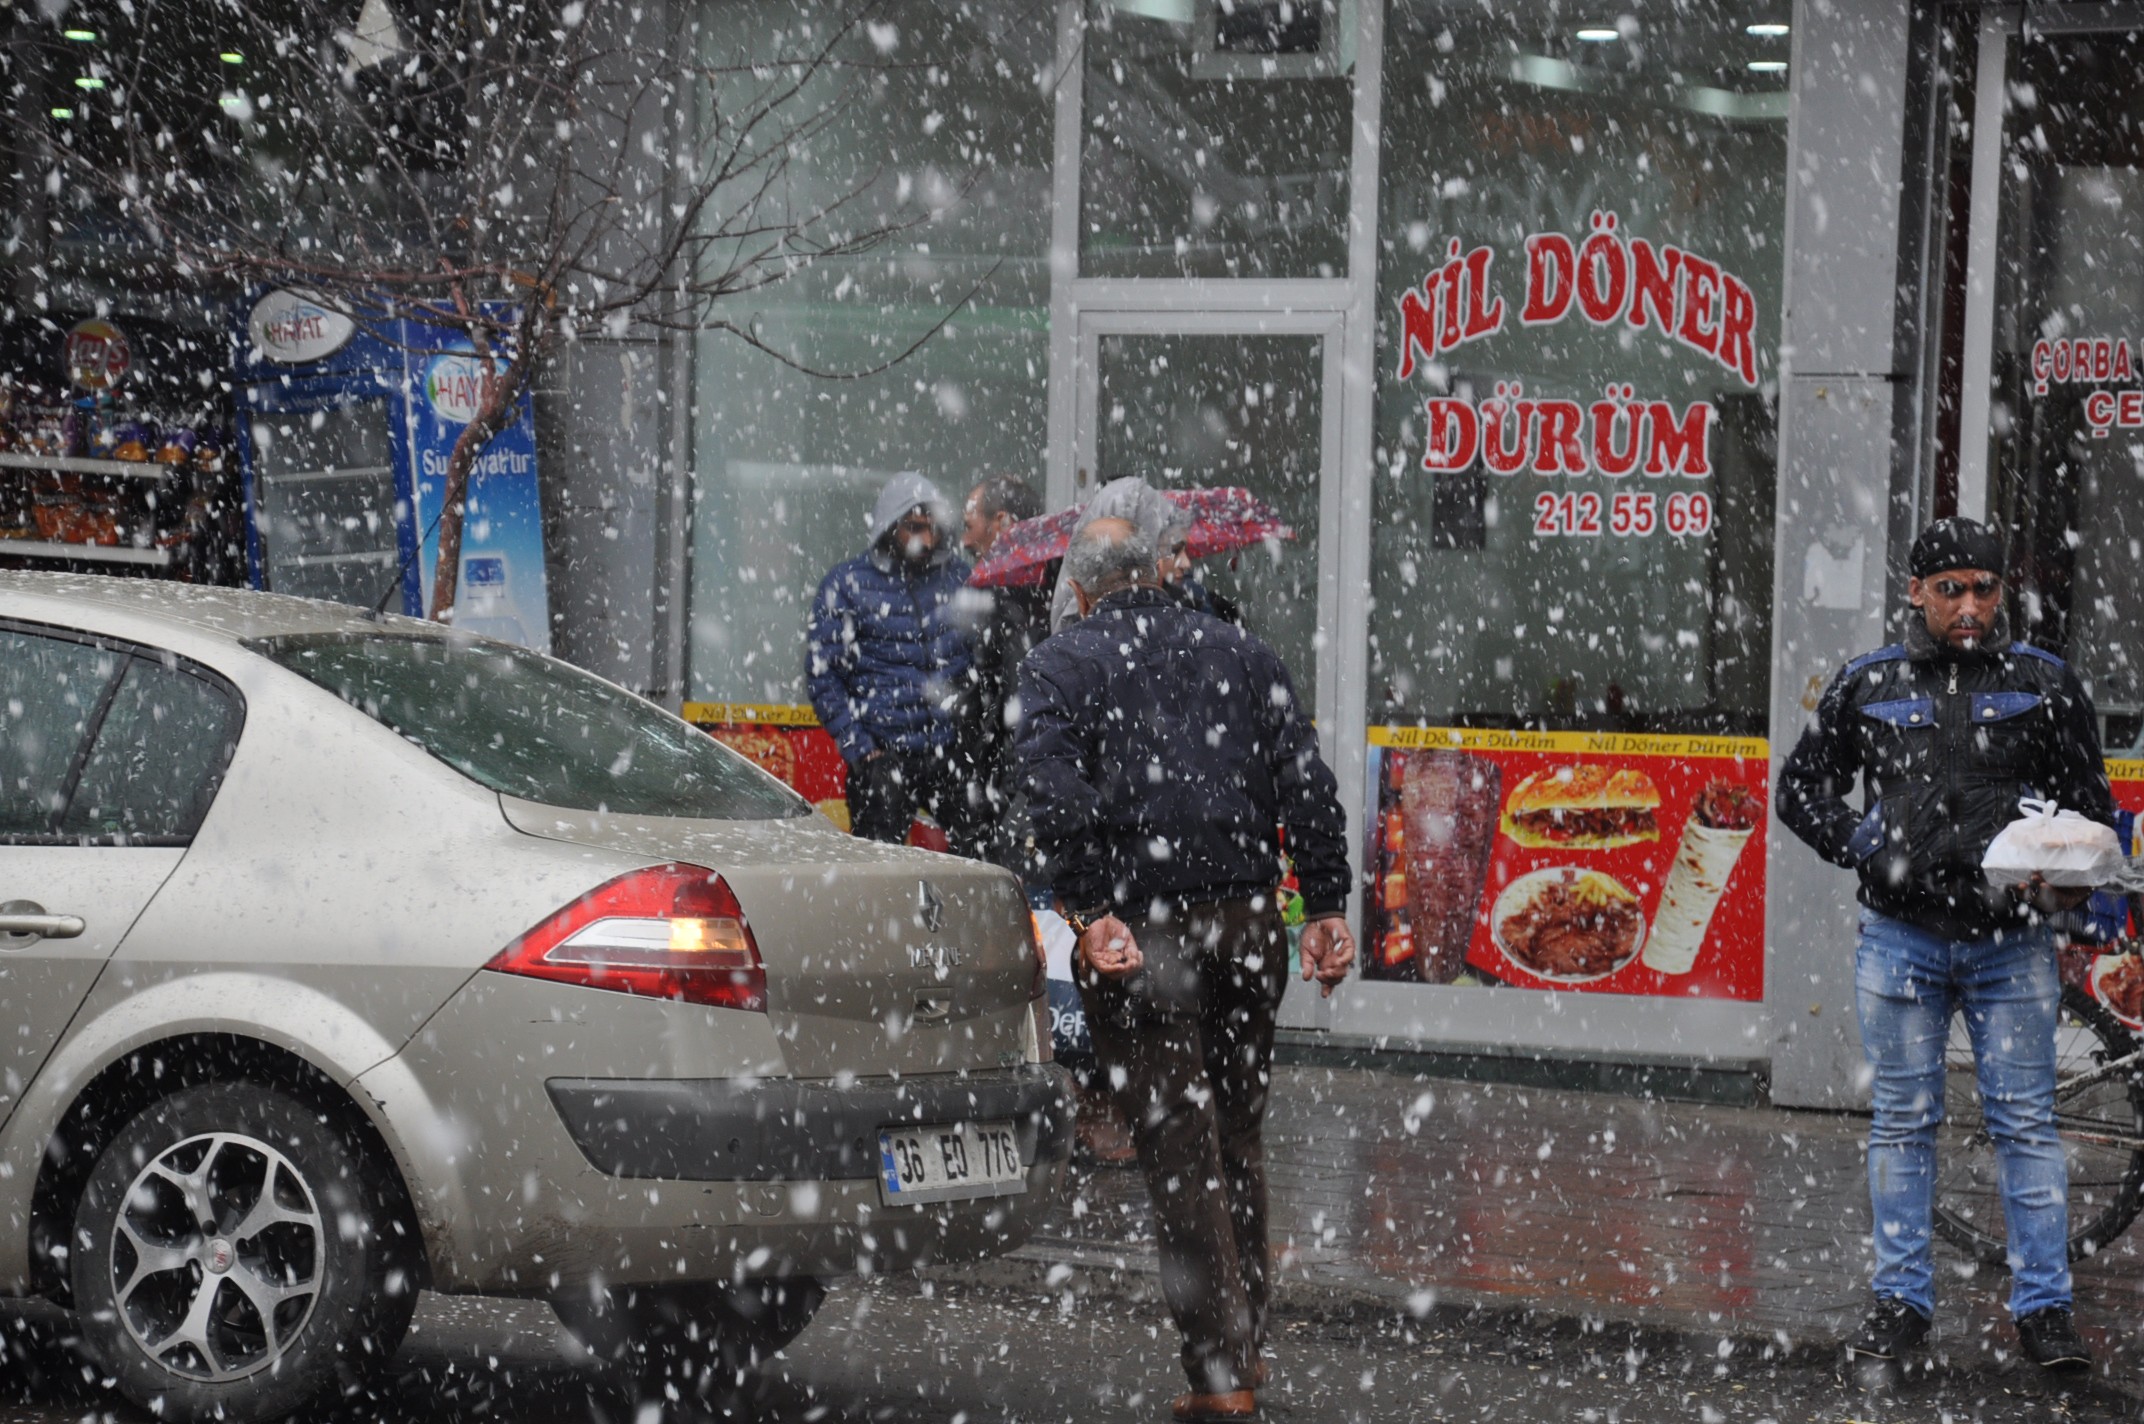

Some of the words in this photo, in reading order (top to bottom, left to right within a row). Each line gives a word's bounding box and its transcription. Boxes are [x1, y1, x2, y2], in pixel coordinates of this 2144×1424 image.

[1397, 235, 1504, 380] NİL
[1520, 209, 1759, 387] DÖNER
[2031, 337, 2132, 396] ÇORBA
[435, 375, 507, 408] HAY
[1421, 380, 1712, 478] DÜRÜM
[422, 448, 448, 476] Su
[1533, 491, 1602, 537] 212
[1609, 491, 1657, 536] 55
[1664, 491, 1712, 535] 69
[1390, 729, 1418, 745] Nil
[1424, 730, 1481, 747] Döer
[1488, 732, 1556, 749] Dürüm
[1588, 736, 1617, 751] Nil
[1623, 737, 1682, 753] Döner
[1688, 739, 1757, 756] Dürüm
[895, 1138, 925, 1184] 36
[977, 1130, 1017, 1176] 776
